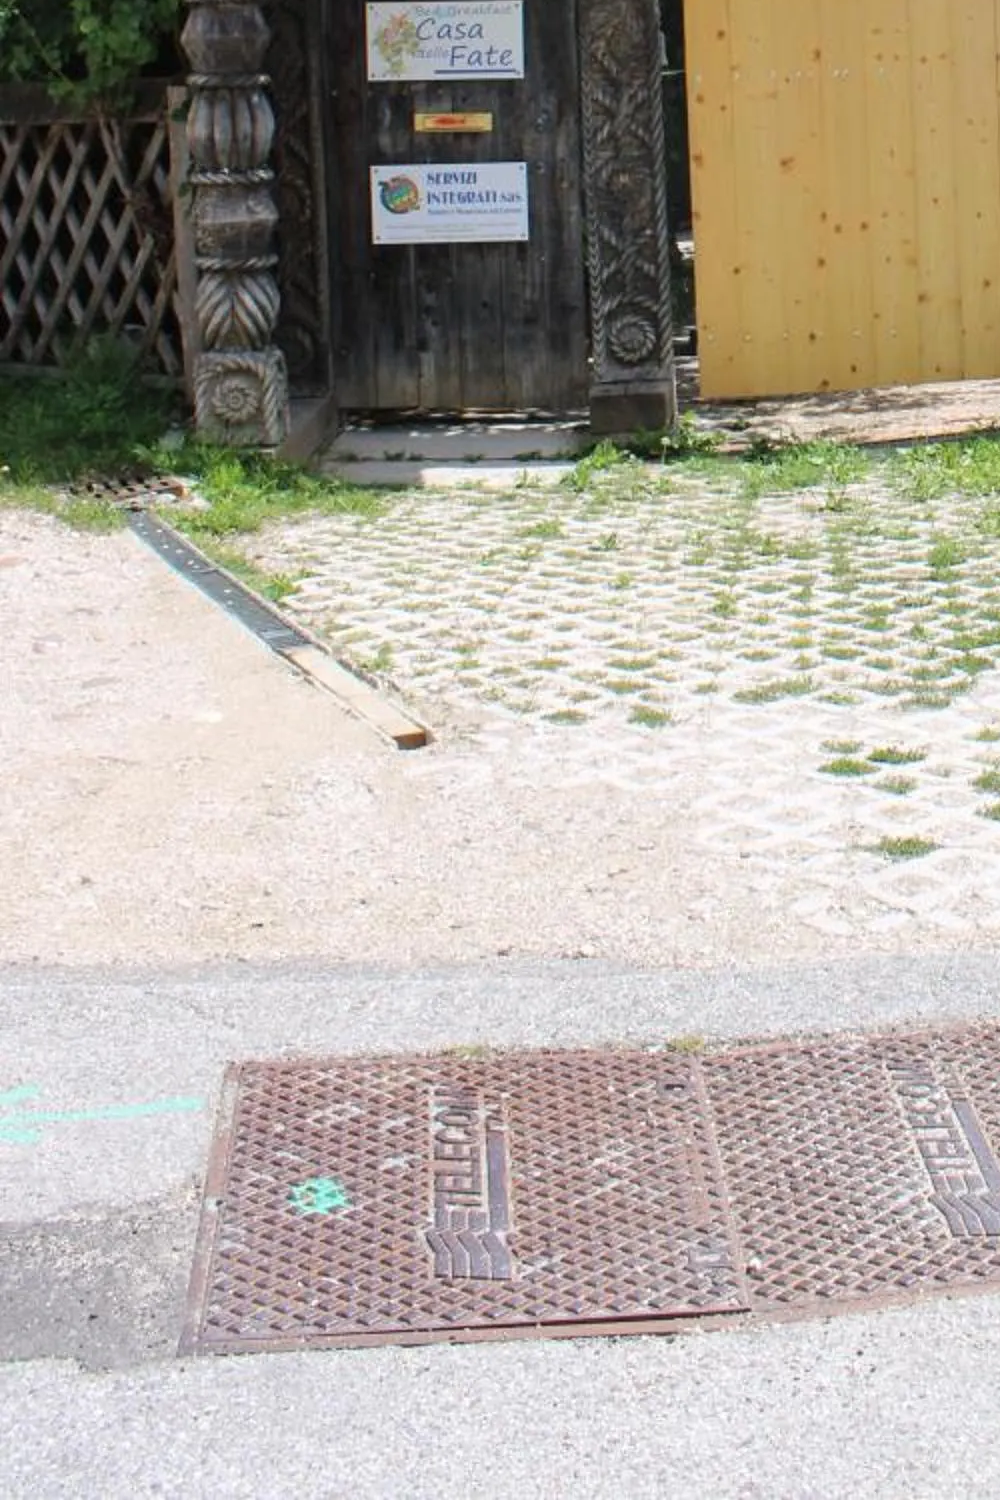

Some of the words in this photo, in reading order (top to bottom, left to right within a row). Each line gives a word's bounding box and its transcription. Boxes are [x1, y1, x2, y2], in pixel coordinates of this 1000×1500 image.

[415, 17, 485, 41] Casa
[449, 44, 513, 67] Fate
[426, 171, 477, 185] SERVIZI
[426, 190, 498, 205] INTEGRATI
[433, 1084, 482, 1210] TELECOM
